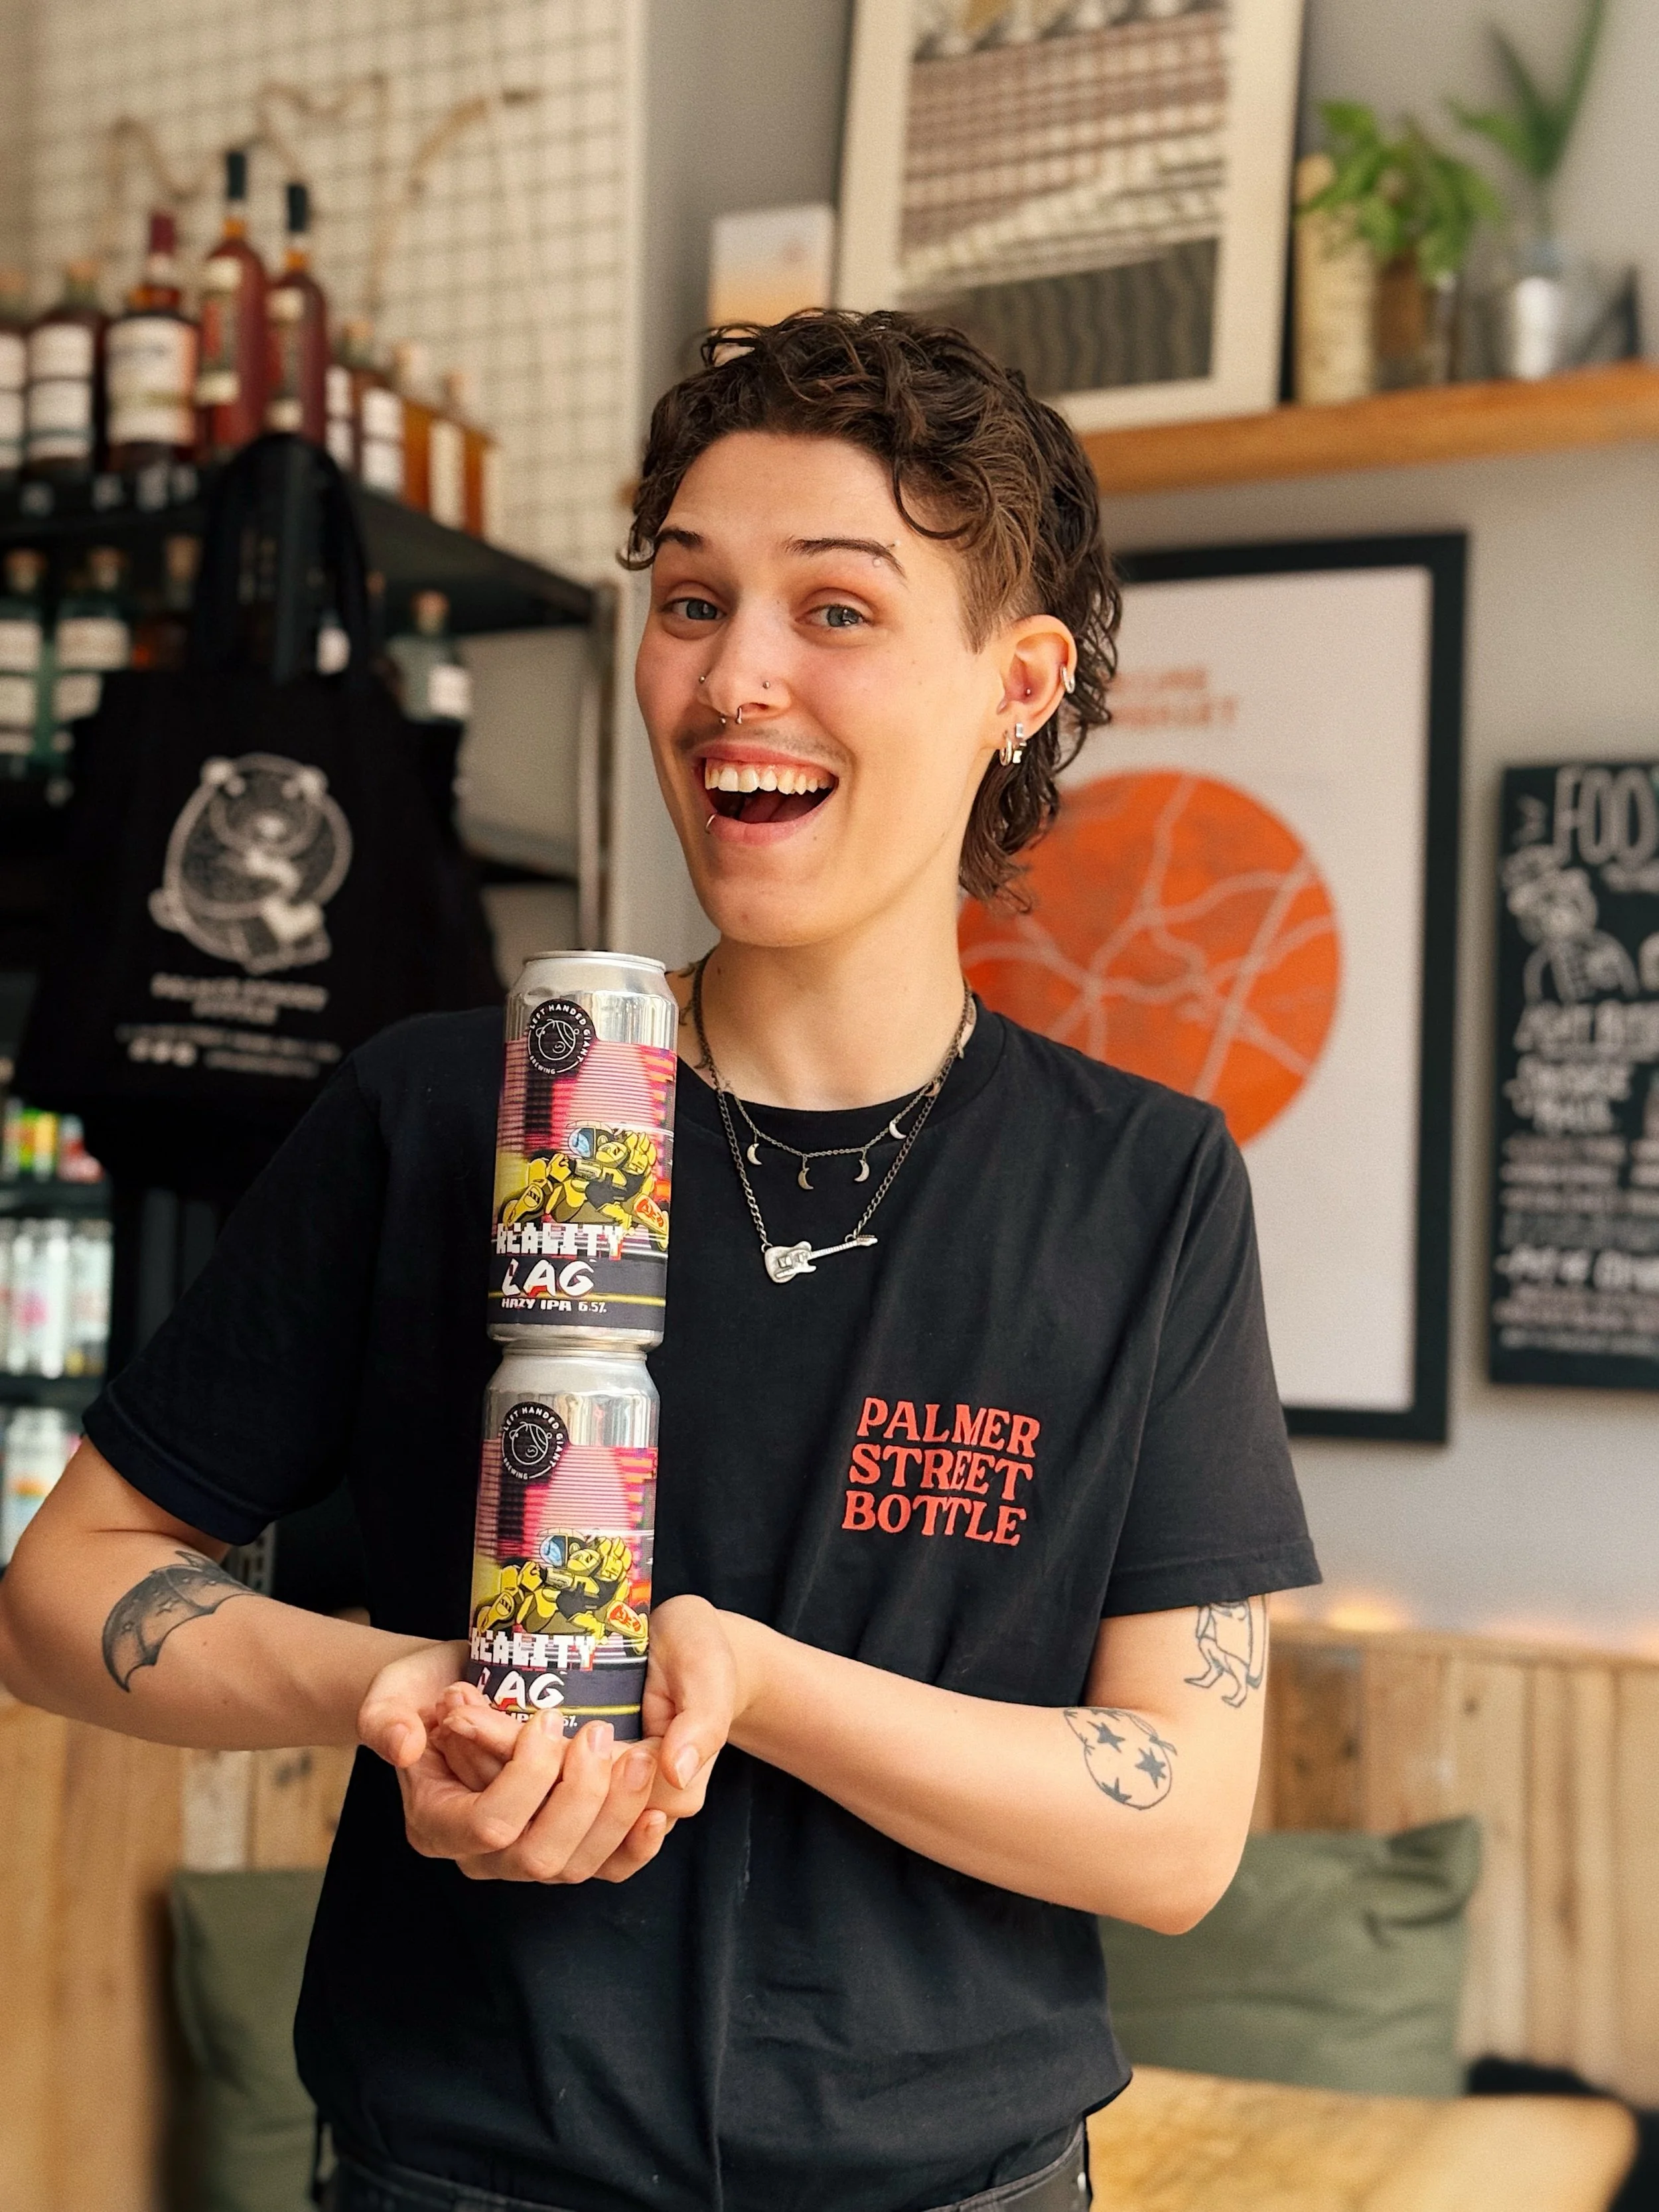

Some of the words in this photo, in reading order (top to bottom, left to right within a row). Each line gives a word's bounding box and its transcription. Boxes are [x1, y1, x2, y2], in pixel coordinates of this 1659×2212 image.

[529, 1007, 545, 1029] LEFT
[548, 1003, 587, 1025] HANDED
[577, 1029, 592, 1063] GIANT
[530, 1055, 556, 1074] BREWING
[496, 1222, 624, 1261] REALITY
[501, 1258, 595, 1297] LAG
[501, 1297, 536, 1310] HAZY
[540, 1299, 572, 1311] IPA
[577, 1301, 607, 1313] 6.5%
[503, 1410, 519, 1431] LEFT
[522, 1406, 559, 1430] HANDED
[549, 1433, 564, 1467] GIANT
[856, 1396, 1041, 1458] PALMER
[503, 1457, 528, 1480] BREWING
[849, 1443, 1034, 1501] STREET
[841, 1489, 1027, 1546] BOTTLE
